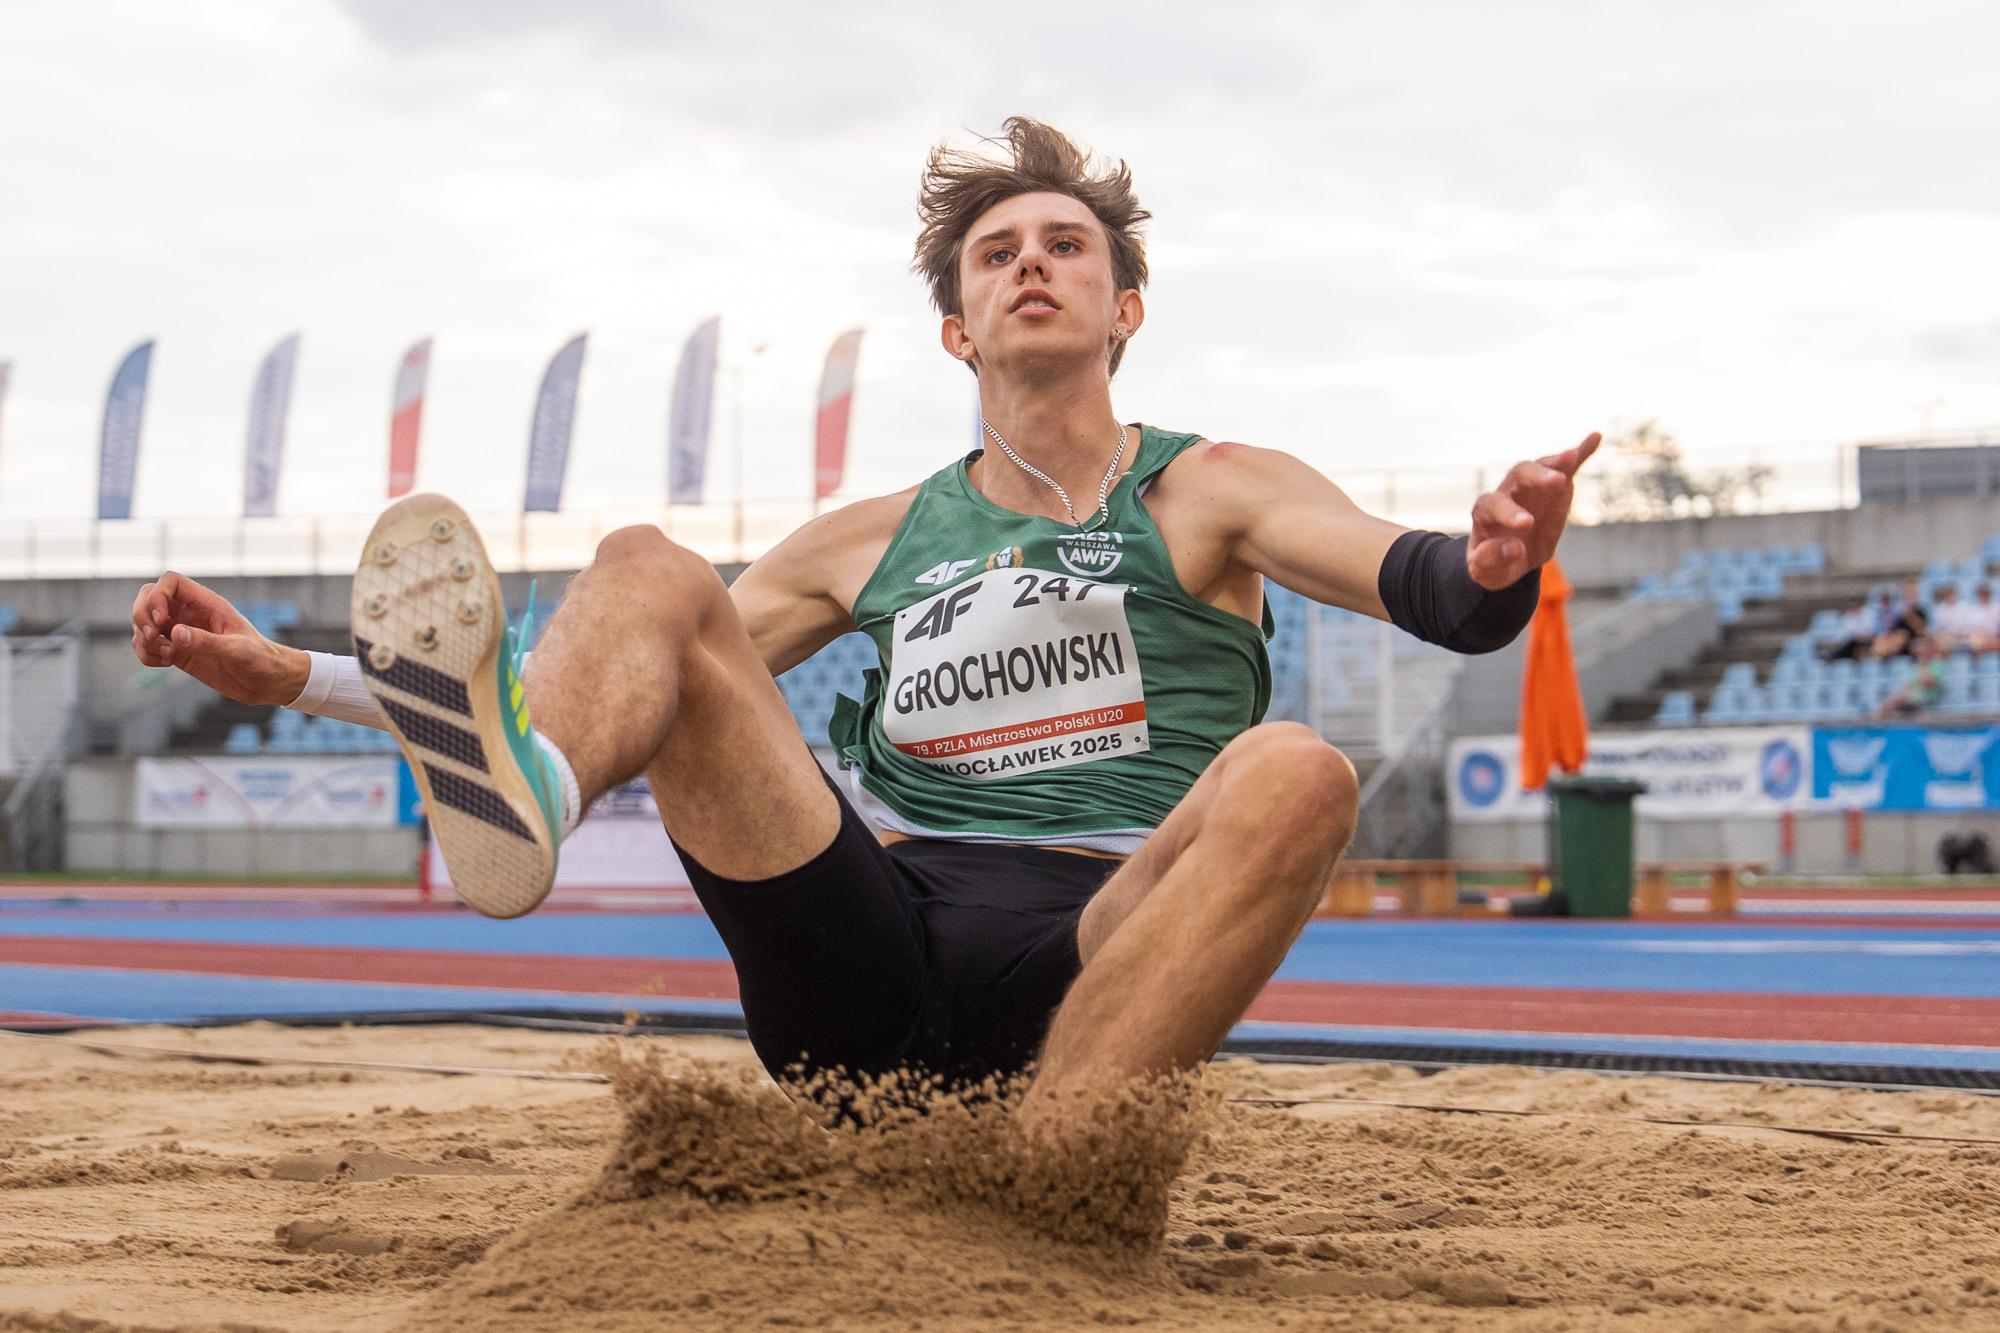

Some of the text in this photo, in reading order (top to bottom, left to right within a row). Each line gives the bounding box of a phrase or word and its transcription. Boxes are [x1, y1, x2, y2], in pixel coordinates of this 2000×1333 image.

[1066, 540, 1116, 551] WARSZAWA
[1069, 547, 1123, 566] AWF
[1012, 574, 1103, 609] 247
[904, 580, 983, 643] 4F
[894, 632, 1125, 715] GROCHOWSKI
[913, 708, 1124, 755] 79. PZLA Mistrzostwa Polski U20
[1070, 732, 1122, 757] 2025
